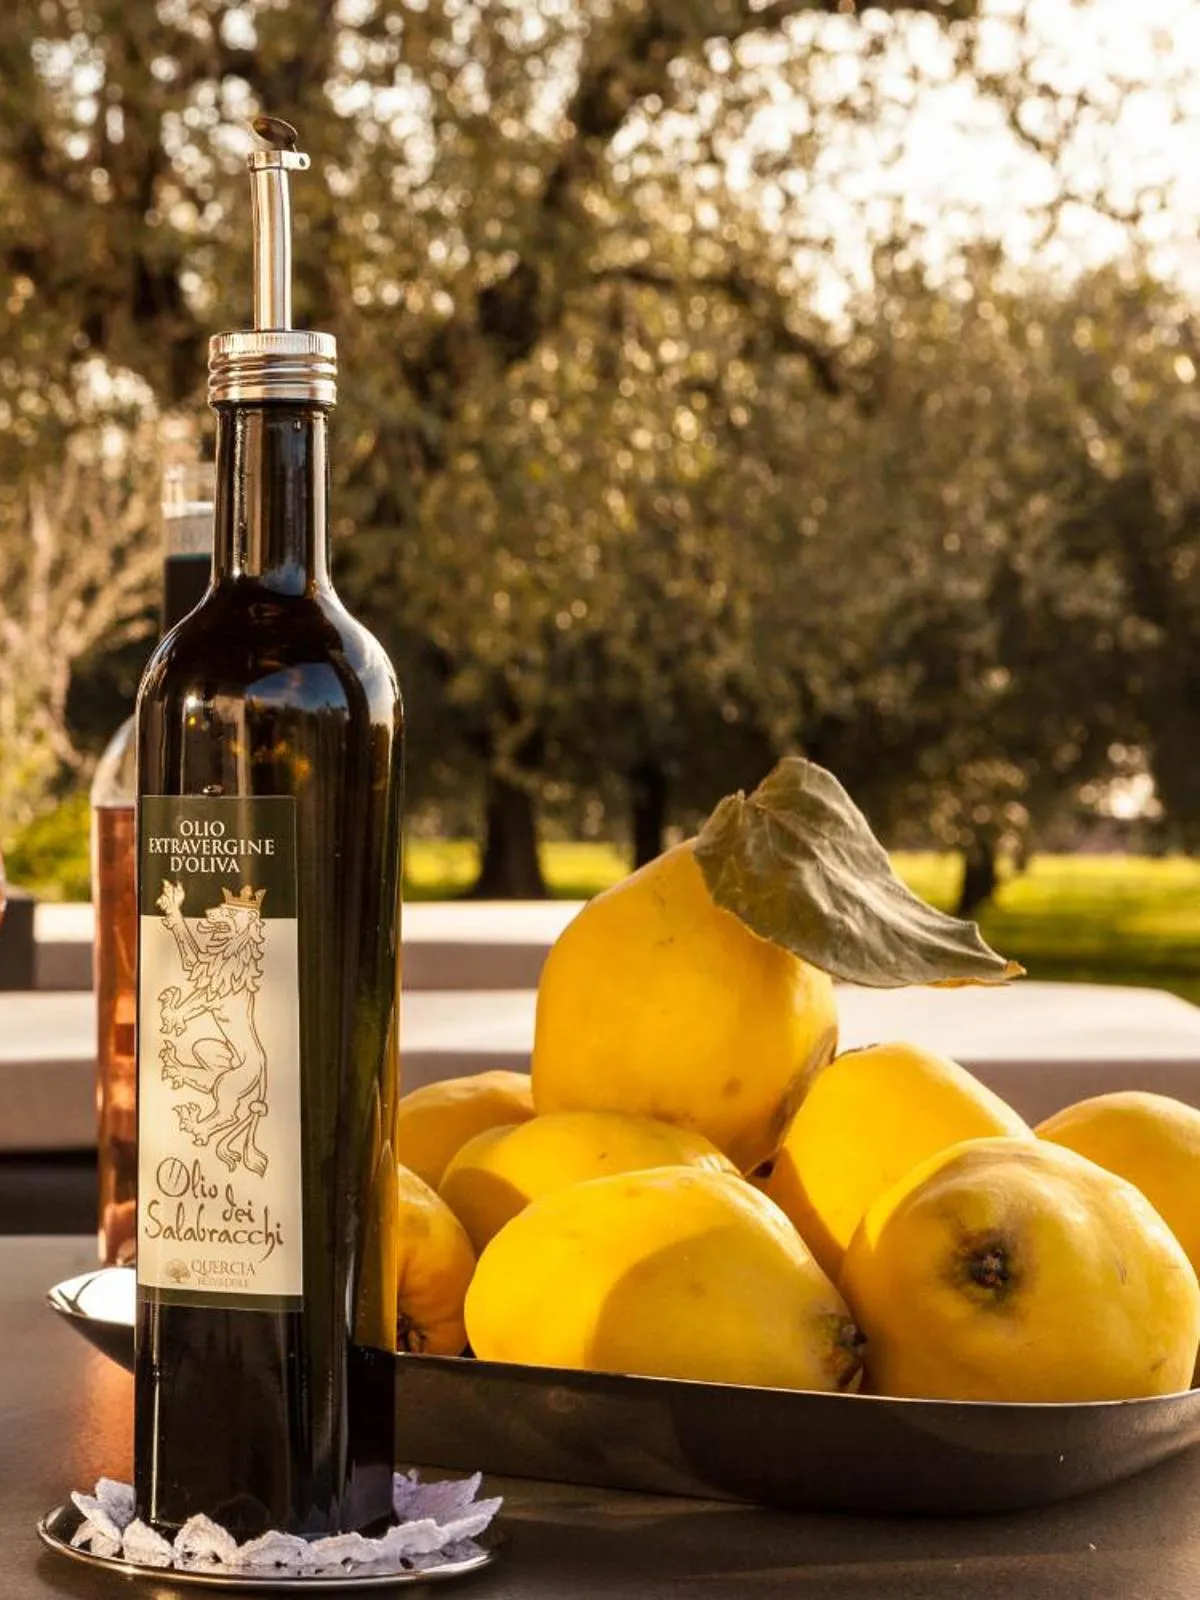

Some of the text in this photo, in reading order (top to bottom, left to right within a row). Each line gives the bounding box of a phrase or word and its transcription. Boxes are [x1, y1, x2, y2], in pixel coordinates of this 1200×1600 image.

[180, 820, 225, 837] OLIO
[149, 838, 275, 855] EXTRAVERGINE
[170, 856, 241, 873] D'OLIVA
[156, 1157, 255, 1223] Olio dei
[145, 1199, 284, 1263] Salabracchi
[191, 1259, 256, 1276] QUERCIA
